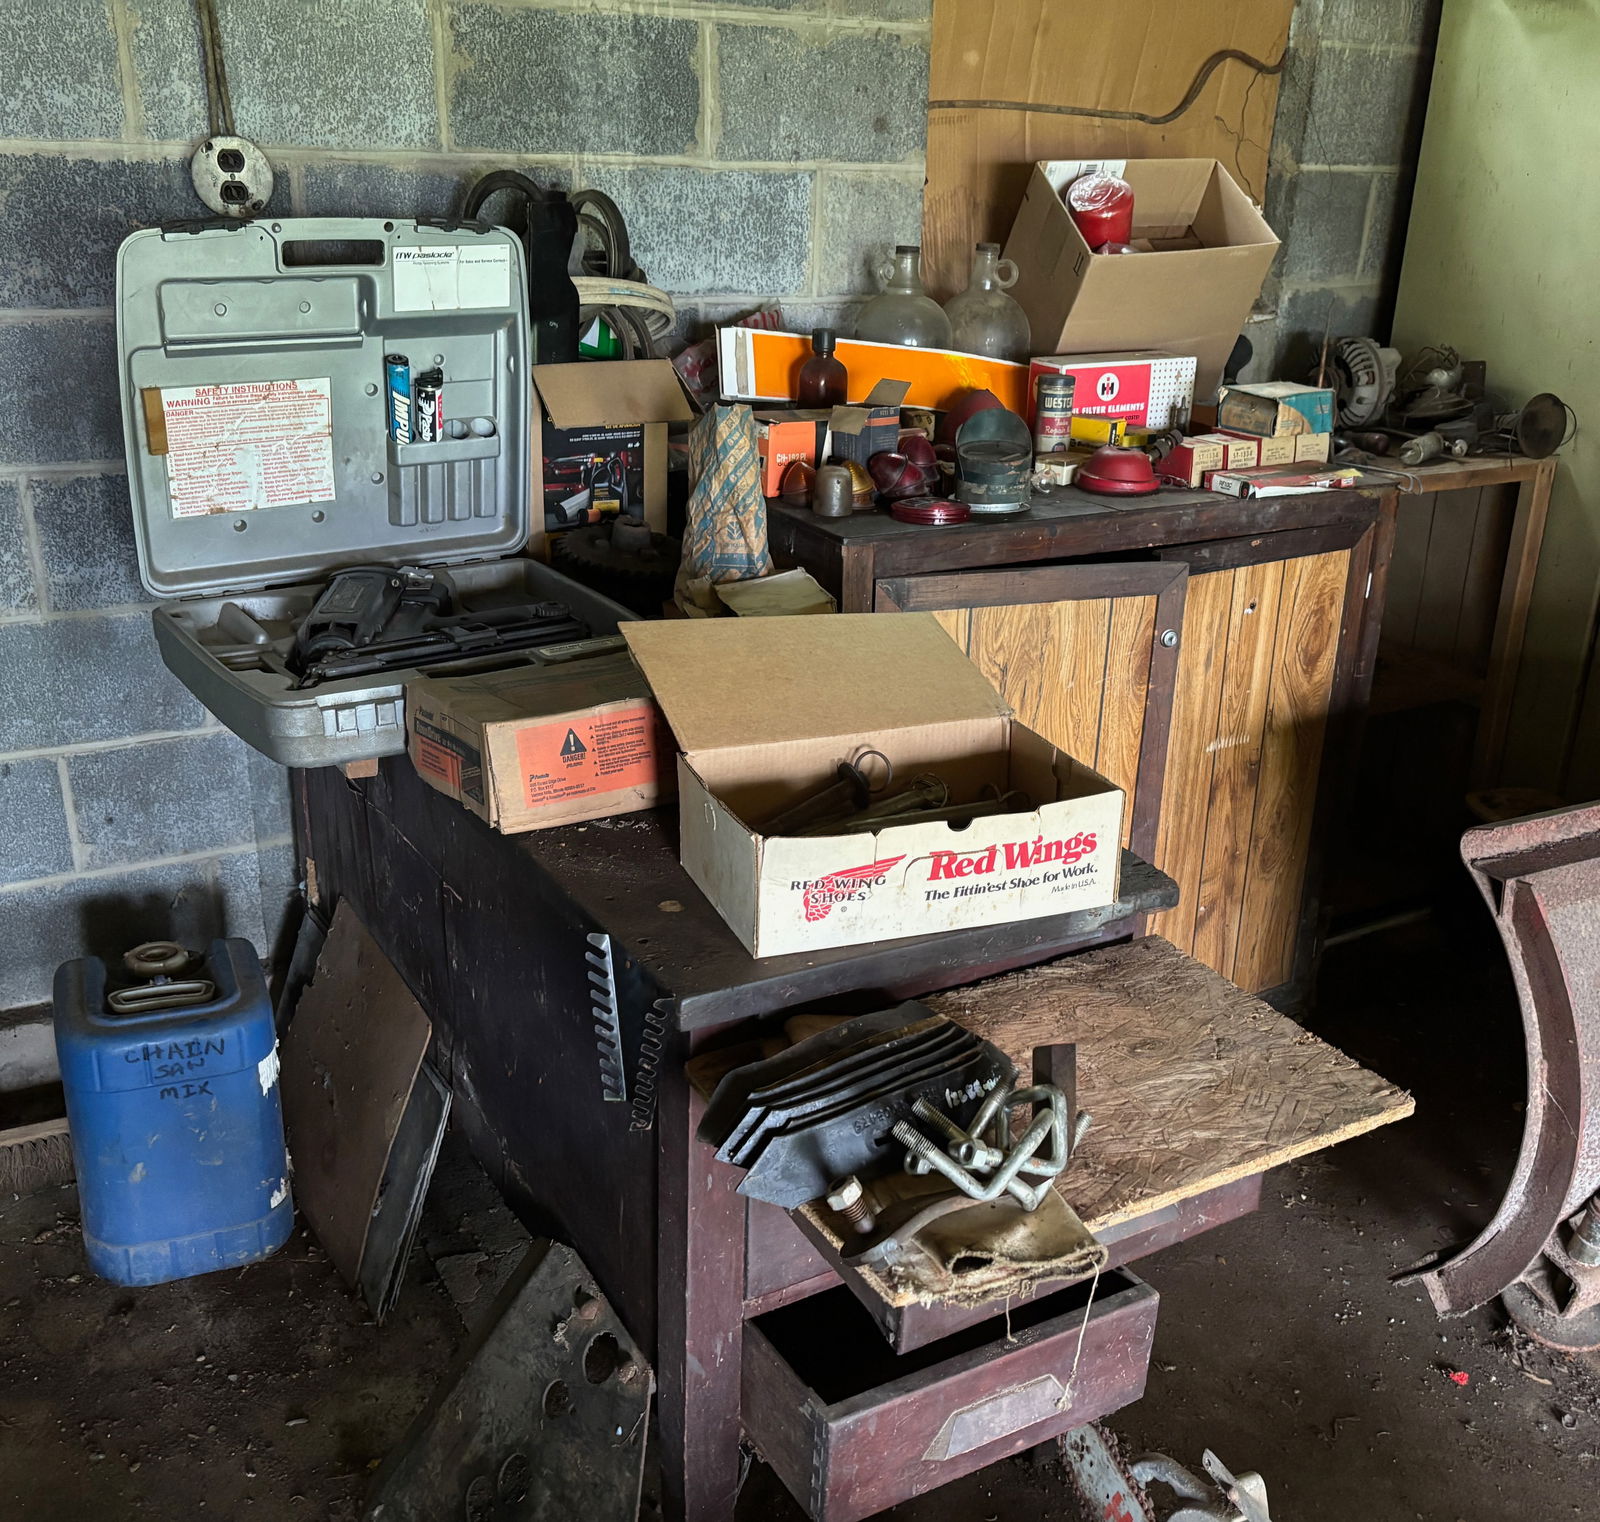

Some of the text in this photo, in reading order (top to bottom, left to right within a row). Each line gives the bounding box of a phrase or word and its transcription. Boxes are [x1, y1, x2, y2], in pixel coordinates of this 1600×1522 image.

[196, 382, 298, 396] SAFETY INSTRUCTIONS
[166, 398, 210, 408] WARNING
[1082, 405, 1106, 414] FILTER
[1108, 402, 1145, 413] ELEMENTS
[562, 752, 586, 763] DANGER!
[926, 832, 1097, 882] Red Wings
[790, 875, 887, 891] RED WING
[925, 864, 1098, 901] The Fittin'est Shoe for Work.
[1051, 885, 1069, 894] Made
[811, 891, 866, 904] SHOES
[124, 1038, 225, 1064] CHAIN
[160, 1081, 213, 1100] MIX
